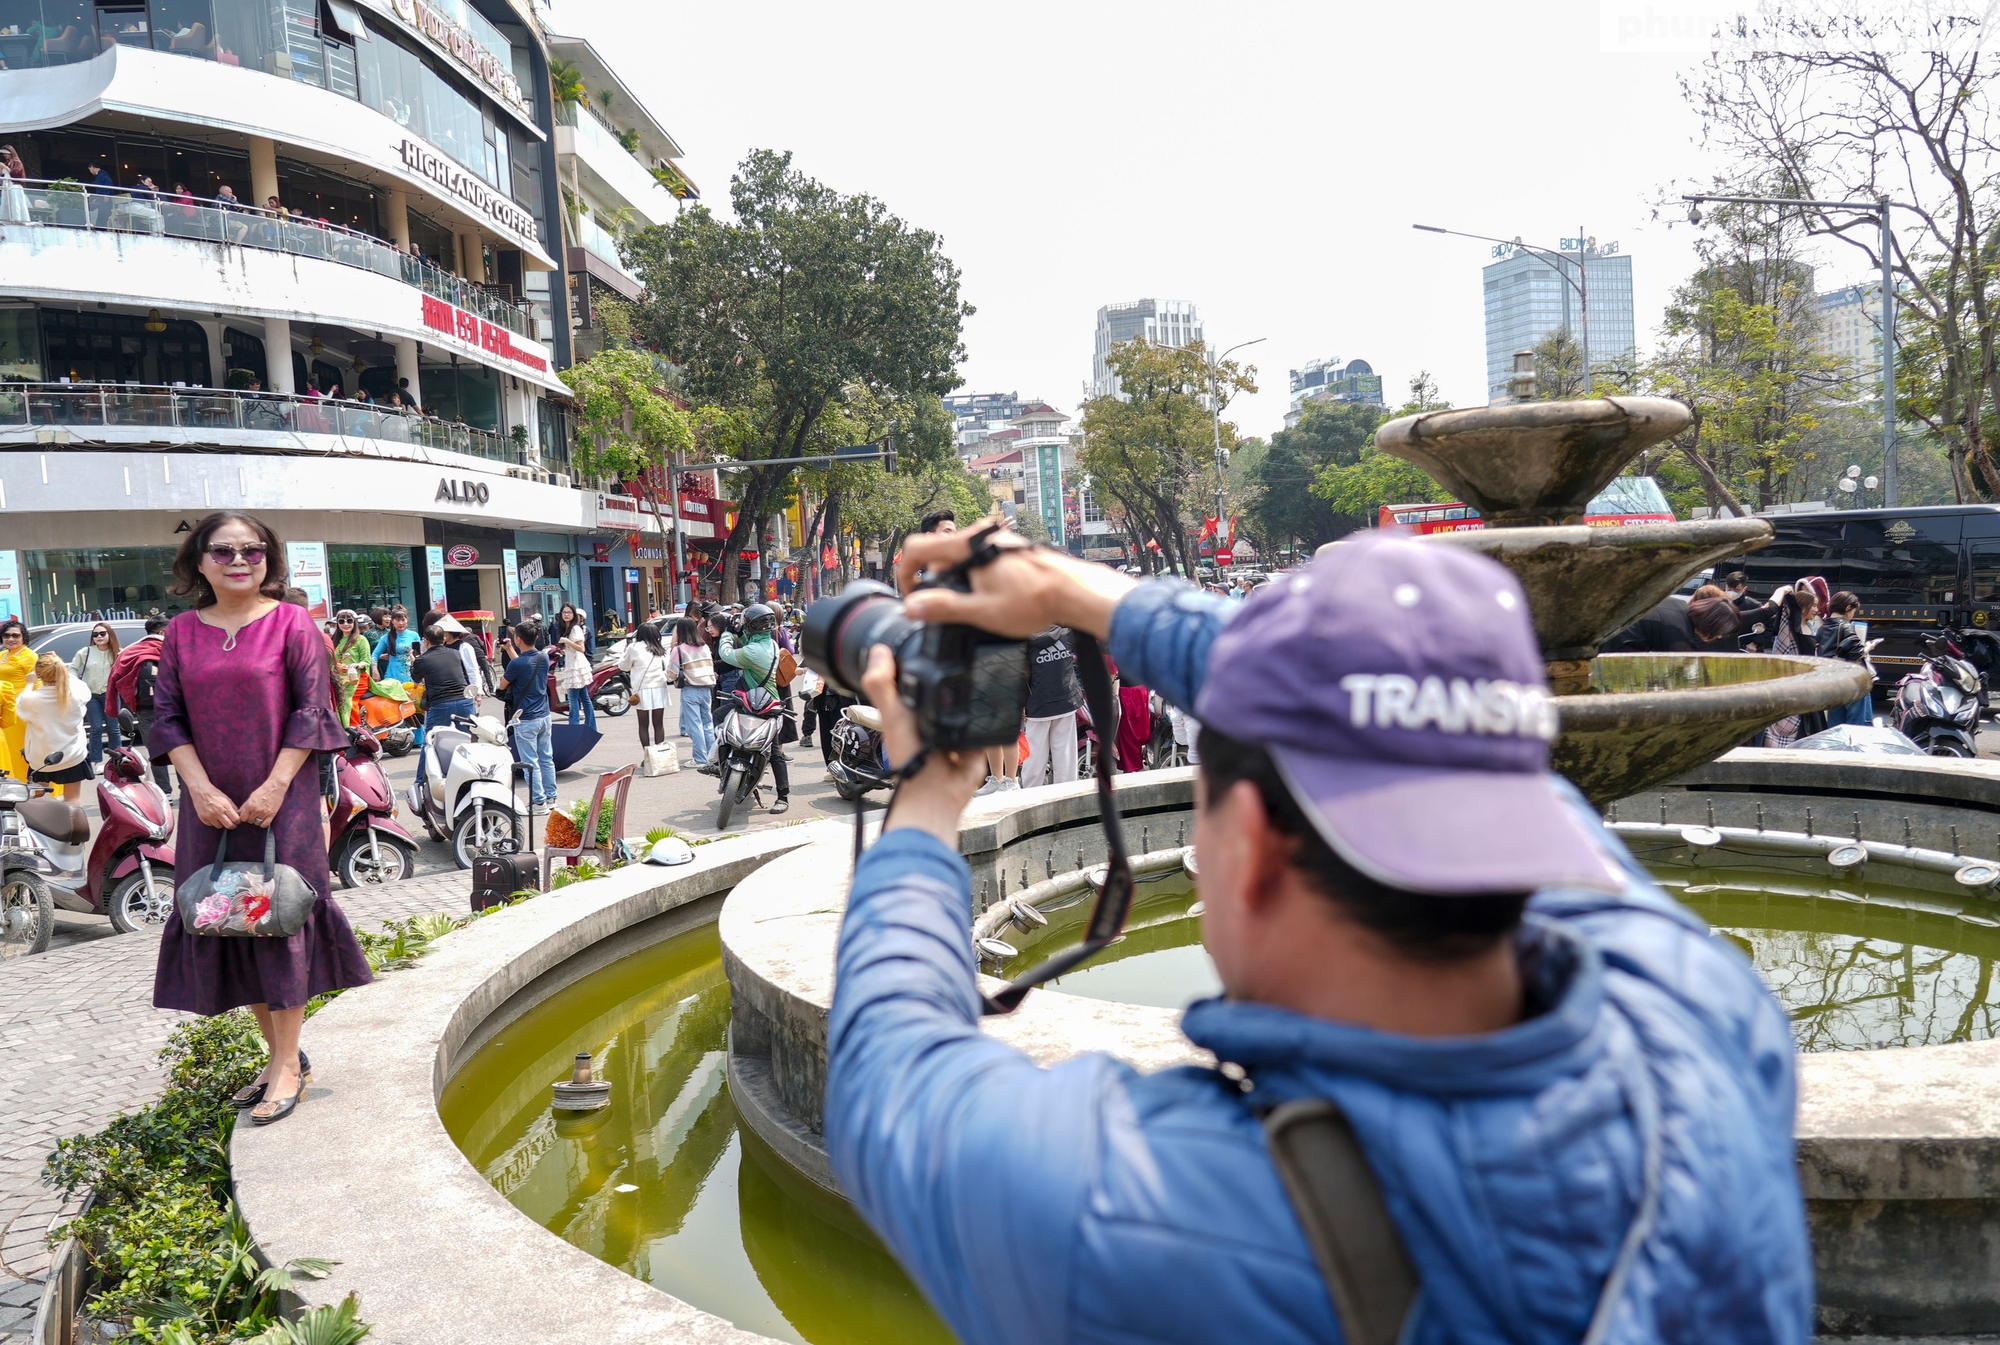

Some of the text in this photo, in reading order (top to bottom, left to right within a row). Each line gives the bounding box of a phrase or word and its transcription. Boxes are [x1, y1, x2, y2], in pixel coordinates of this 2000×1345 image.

[401, 139, 539, 243] HIGHLANDS COFFEE
[435, 477, 490, 505] ALDO
[1036, 650, 1071, 664] adidas
